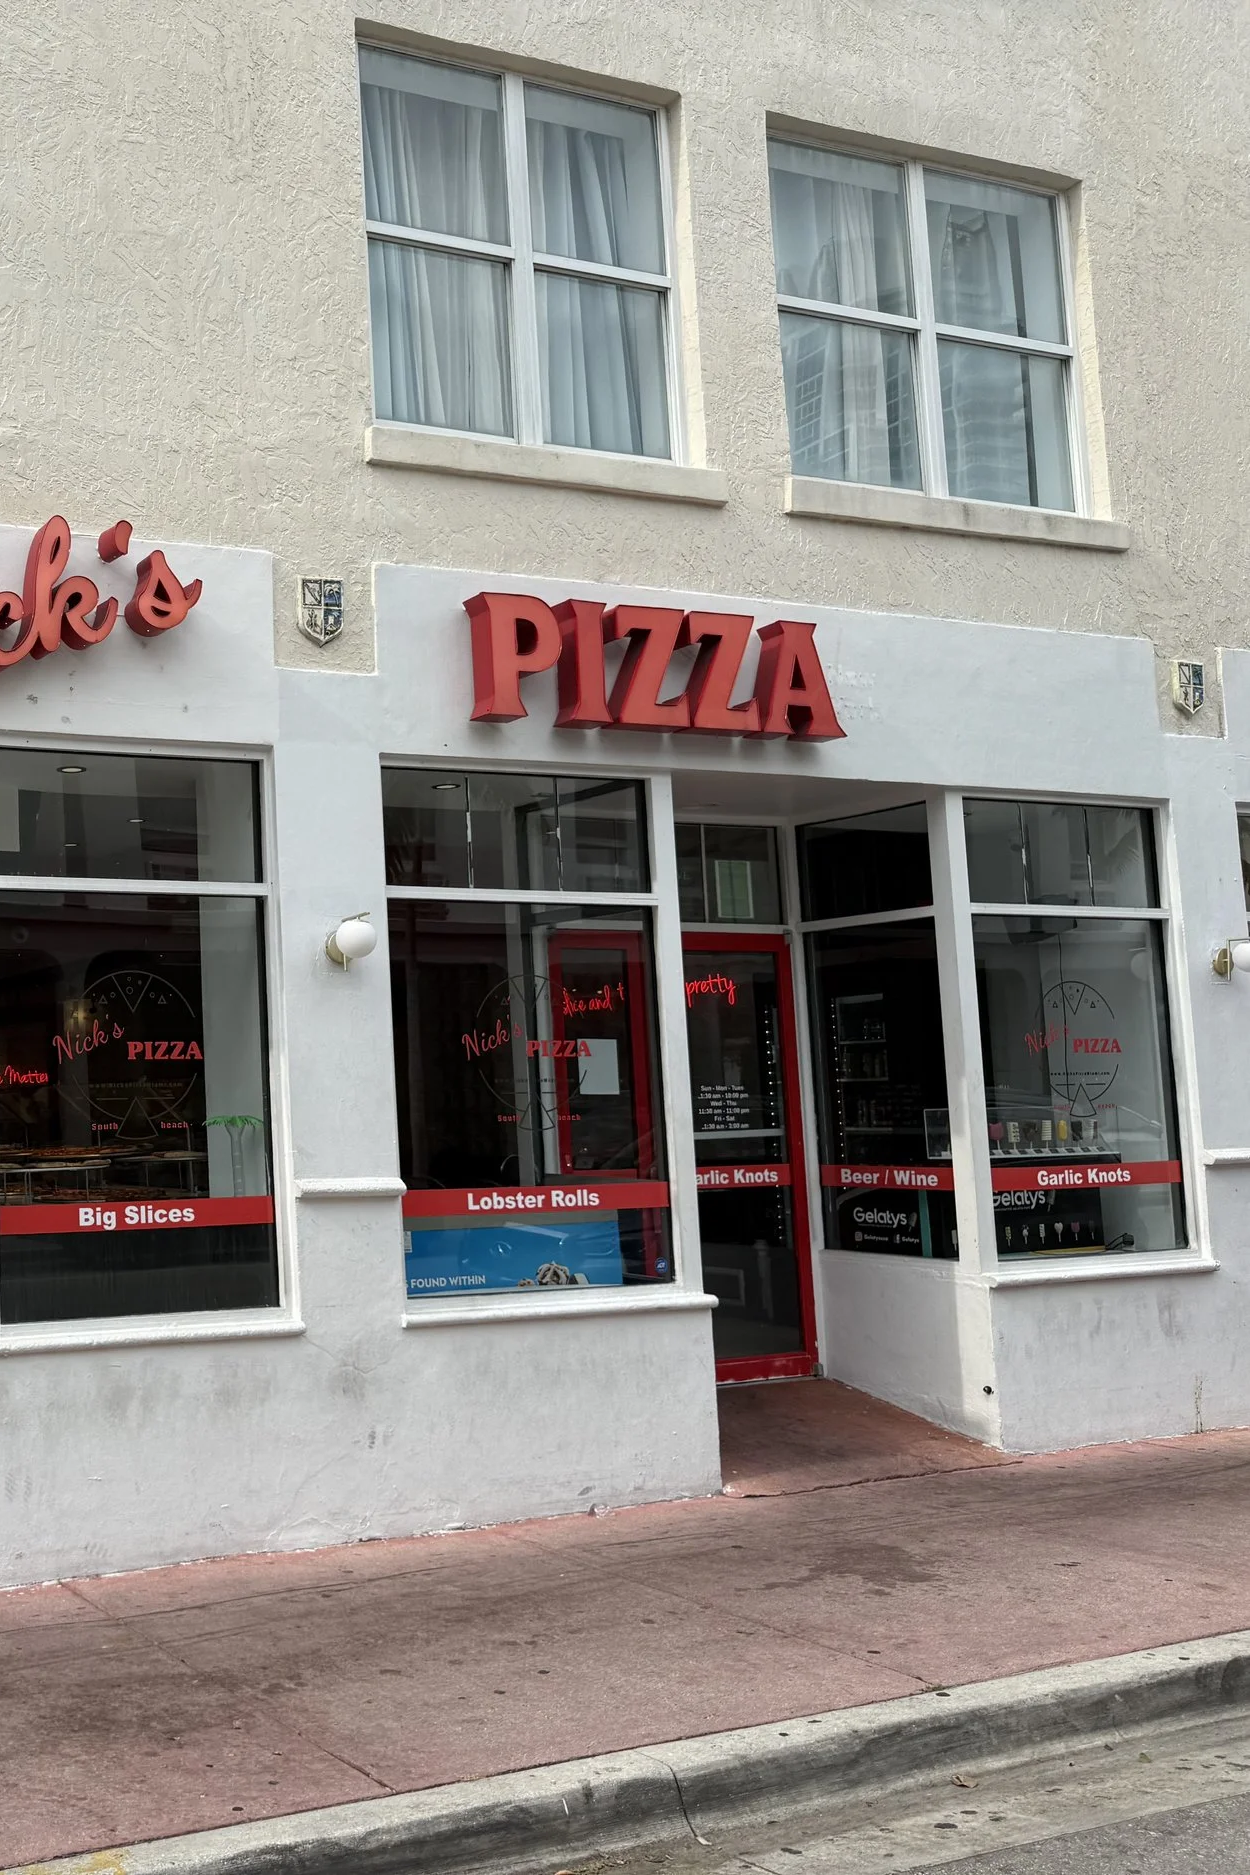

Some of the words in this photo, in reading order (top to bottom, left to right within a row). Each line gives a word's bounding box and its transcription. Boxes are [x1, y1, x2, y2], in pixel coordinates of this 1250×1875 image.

[462, 592, 848, 743] PIZZA
[685, 973, 736, 1008] pretty
[53, 1013, 125, 1065] Nick's
[461, 1014, 524, 1061] Nick's
[1073, 1038, 1122, 1054] PIZZA
[127, 1041, 204, 1060] PIZZA
[526, 1040, 592, 1057] PIZZA
[696, 1169, 729, 1184] arlic
[733, 1168, 778, 1184] Knots
[841, 1168, 879, 1184] Beer
[893, 1170, 938, 1187] Wine
[1037, 1169, 1083, 1186] Garlic
[1087, 1168, 1131, 1184] Knots
[467, 1192, 546, 1211] Lobster
[551, 1189, 599, 1208] Rolls
[79, 1207, 116, 1231] Big
[124, 1205, 195, 1225] Slices
[853, 1206, 908, 1229] Gelatys
[410, 1277, 447, 1288] FOUND
[449, 1274, 486, 1286] WITHIN
